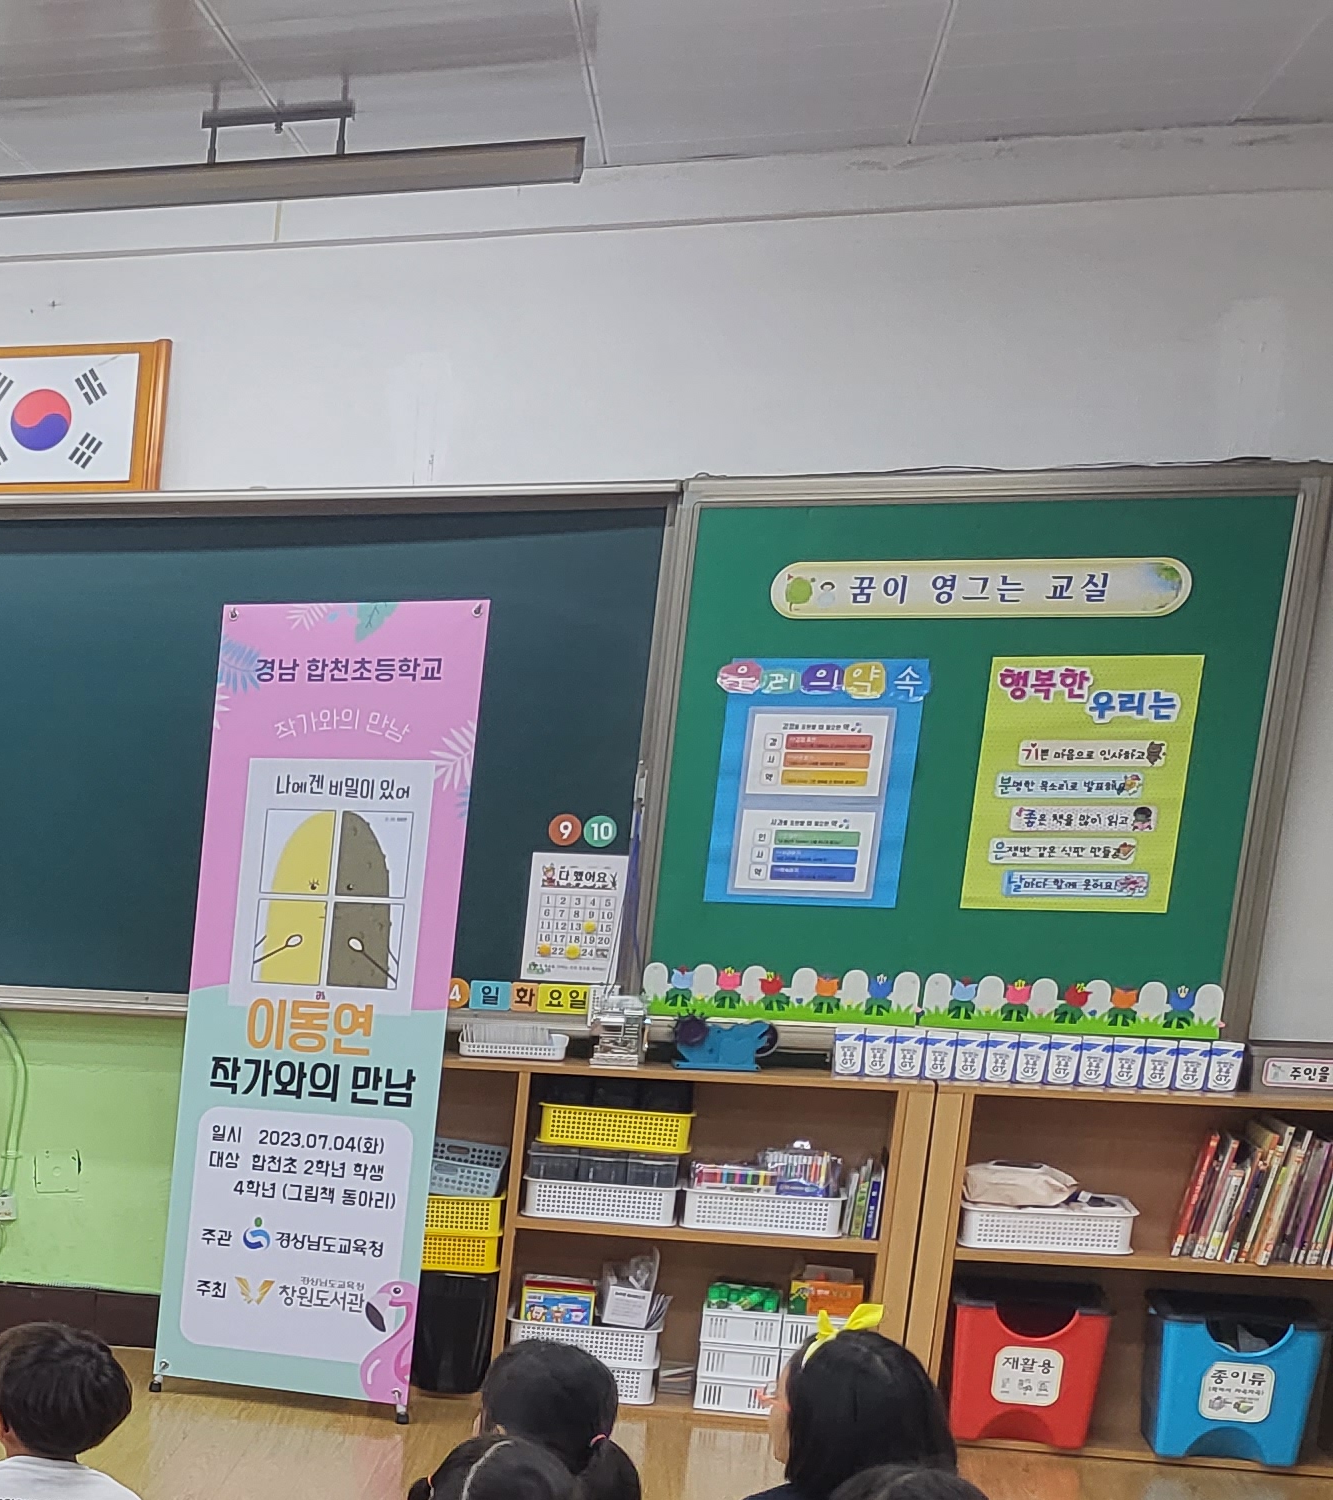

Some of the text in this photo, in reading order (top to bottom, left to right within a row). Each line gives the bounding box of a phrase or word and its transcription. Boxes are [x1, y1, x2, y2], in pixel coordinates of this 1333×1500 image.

[849, 573, 1109, 604] 꿈이 영그는 교실
[255, 658, 443, 682] 경남 합천초등학교
[853, 665, 924, 698] 약속
[1000, 668, 1089, 700] 행복한
[1089, 691, 1176, 720] 우리는
[274, 708, 411, 743] 작가와의 만남
[1054, 750, 1094, 760] 마음으로
[276, 774, 411, 800] 나에겐 비밀이 있어
[999, 776, 1035, 794] 분명한
[559, 821, 573, 840] 9
[590, 823, 613, 840] 10
[559, 870, 607, 883] 다 했어요
[583, 936, 595, 944] 19
[450, 985, 587, 1008] 4 일 화 요일
[246, 998, 374, 1056] 이동연
[209, 1056, 416, 1108] 작가와의 만남
[1290, 1066, 1331, 1082] 주인을
[212, 1125, 384, 1154] 일시 2023.07.04(화)
[209, 1151, 384, 1182] 대상 합천초 2학년 학생
[233, 1180, 396, 1209] 4학년 (그림책 동아리)
[201, 1229, 383, 1258] 주관 경상남도교육청
[196, 1280, 365, 1313] 주최 창원도서관
[1002, 1356, 1055, 1375] 재활용
[1211, 1370, 1266, 1386] 종이류
